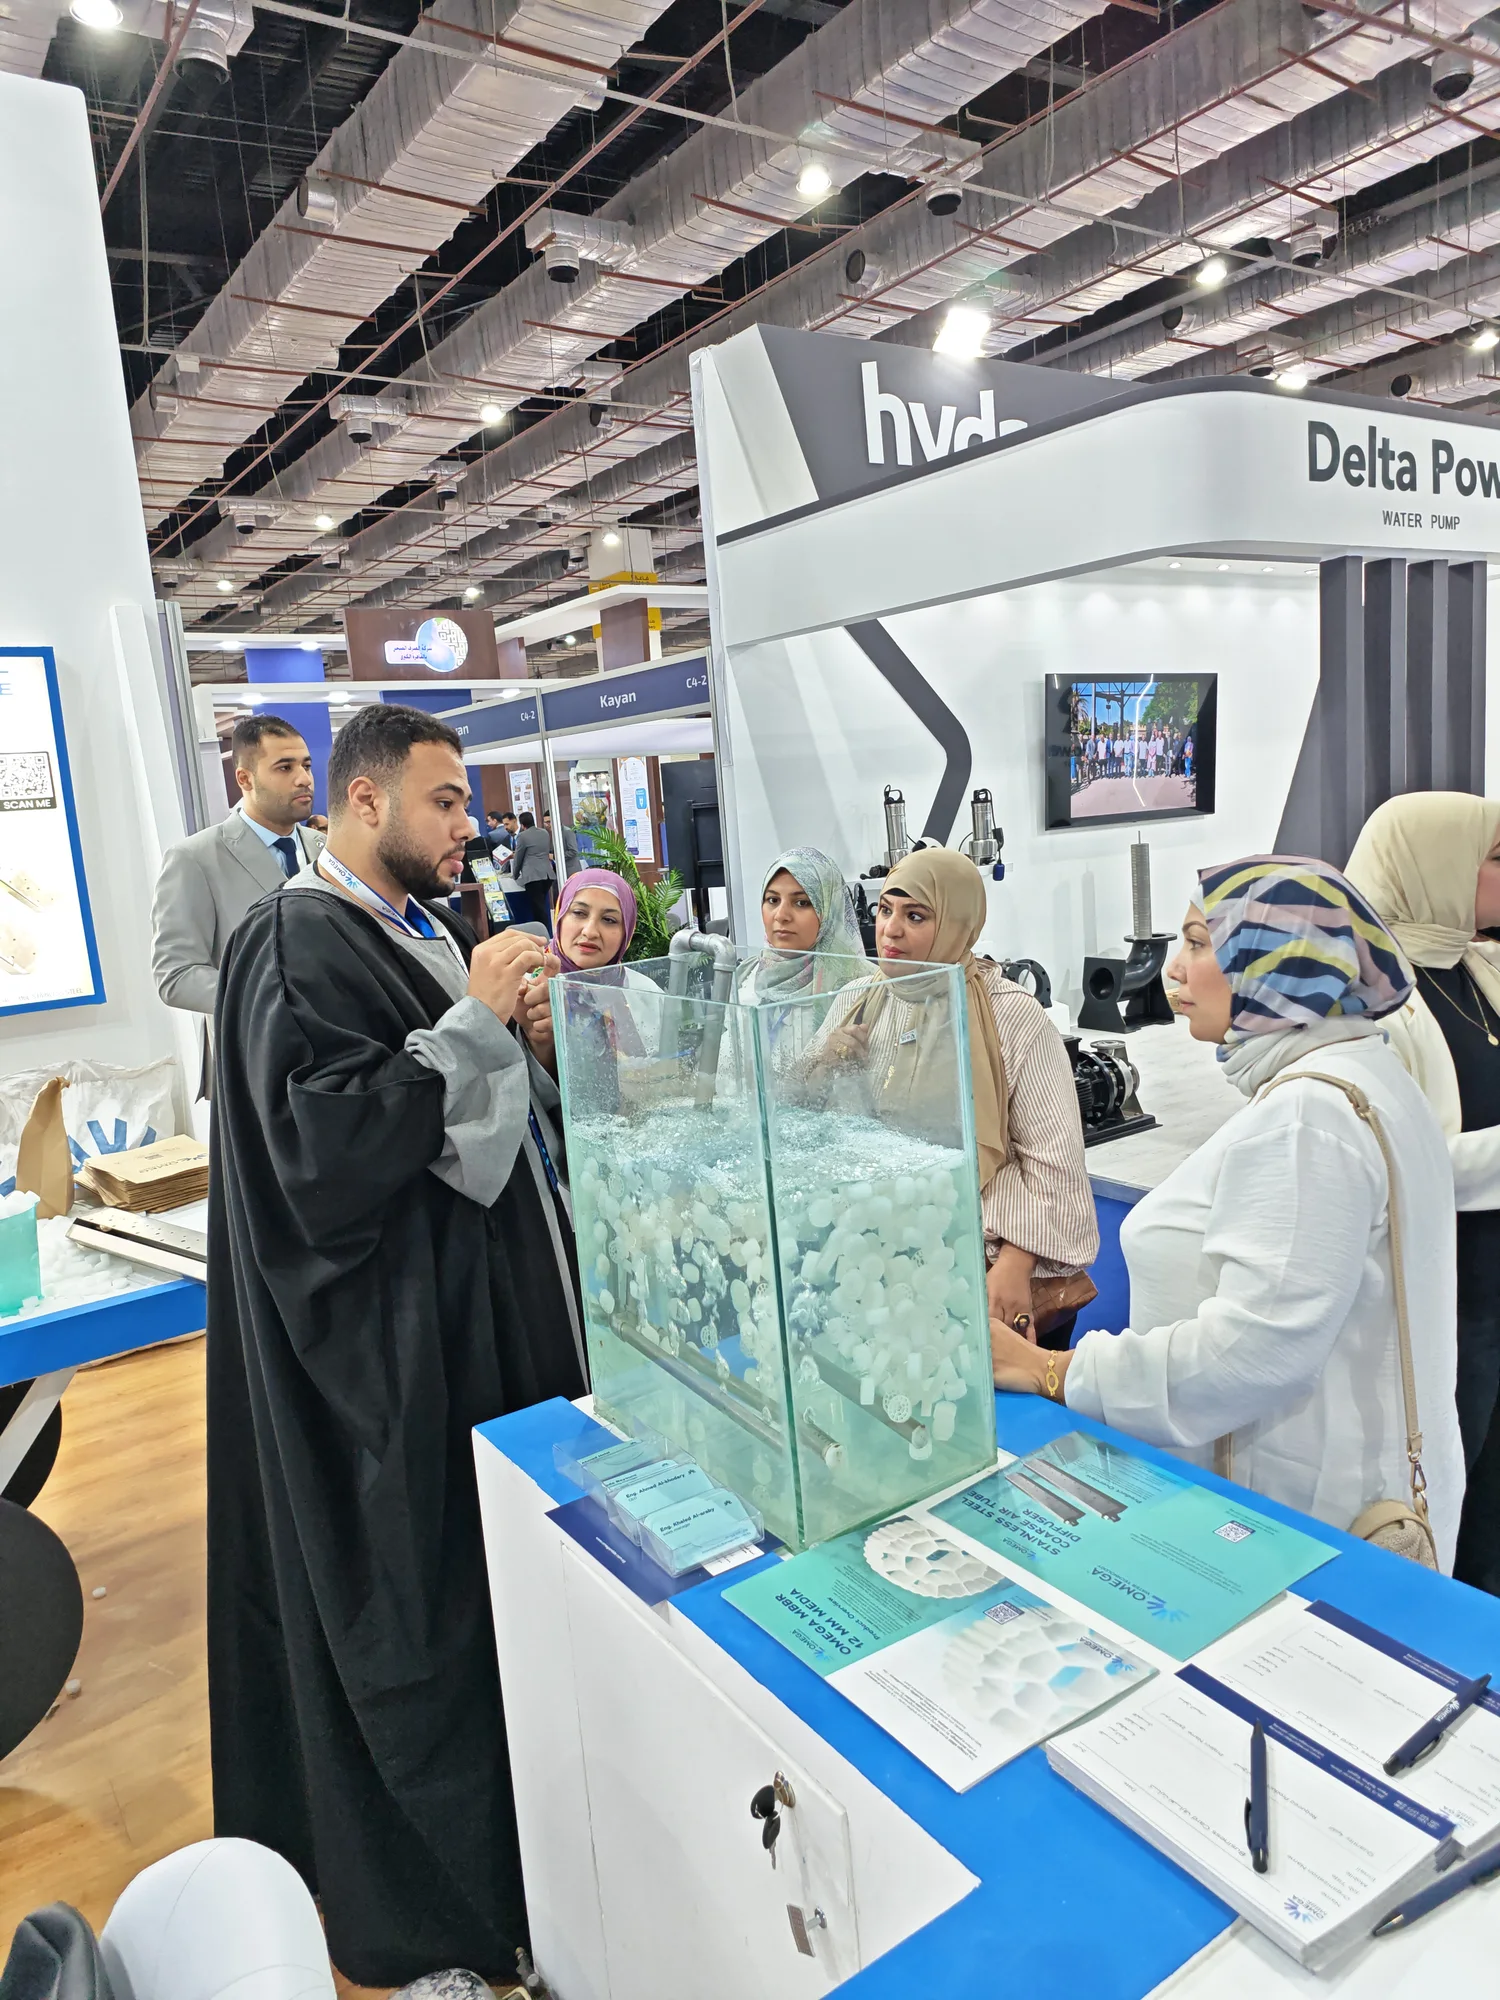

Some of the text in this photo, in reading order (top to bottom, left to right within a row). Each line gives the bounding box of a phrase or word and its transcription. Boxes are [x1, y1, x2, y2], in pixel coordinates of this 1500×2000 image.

[1308, 420, 1417, 492] Delta
[1382, 510, 1460, 531] WATER PUMP
[686, 675, 707, 689] C4-2
[600, 691, 637, 709] Kayan
[520, 711, 535, 722] C4-2
[3, 799, 51, 810] SCAN ME
[329, 858, 346, 876] OMEGA
[626, 1490, 638, 1499] Eng.
[639, 1483, 657, 1494] Ahmed
[966, 1490, 998, 1507] TUBE
[957, 1496, 995, 1517] STEEL
[997, 1507, 1020, 1519] AIR
[660, 1506, 715, 1533] Eng. Khaled Al-araby
[1021, 1508, 1082, 1541] DIFFUSER
[993, 1516, 1061, 1554] STAINLESS
[1019, 1519, 1071, 1548] COARSE
[1000, 1538, 1028, 1553] OMEGA
[1087, 1567, 1147, 1601] OMEGA
[773, 1593, 809, 1618] MBBR
[786, 1588, 827, 1616] MEDIA
[823, 1617, 850, 1635] MM
[824, 1597, 882, 1639] Product Overview
[790, 1629, 816, 1649] OMEGA
[804, 1619, 853, 1655] OMEGA
[846, 1636, 865, 1648] 12
[1077, 1636, 1112, 1658] OMEGA
[1434, 1704, 1452, 1722] OMEGA
[1189, 1815, 1211, 1830] Card
[1209, 1829, 1246, 1856] Business
[1290, 1894, 1324, 1919] OMEGA
